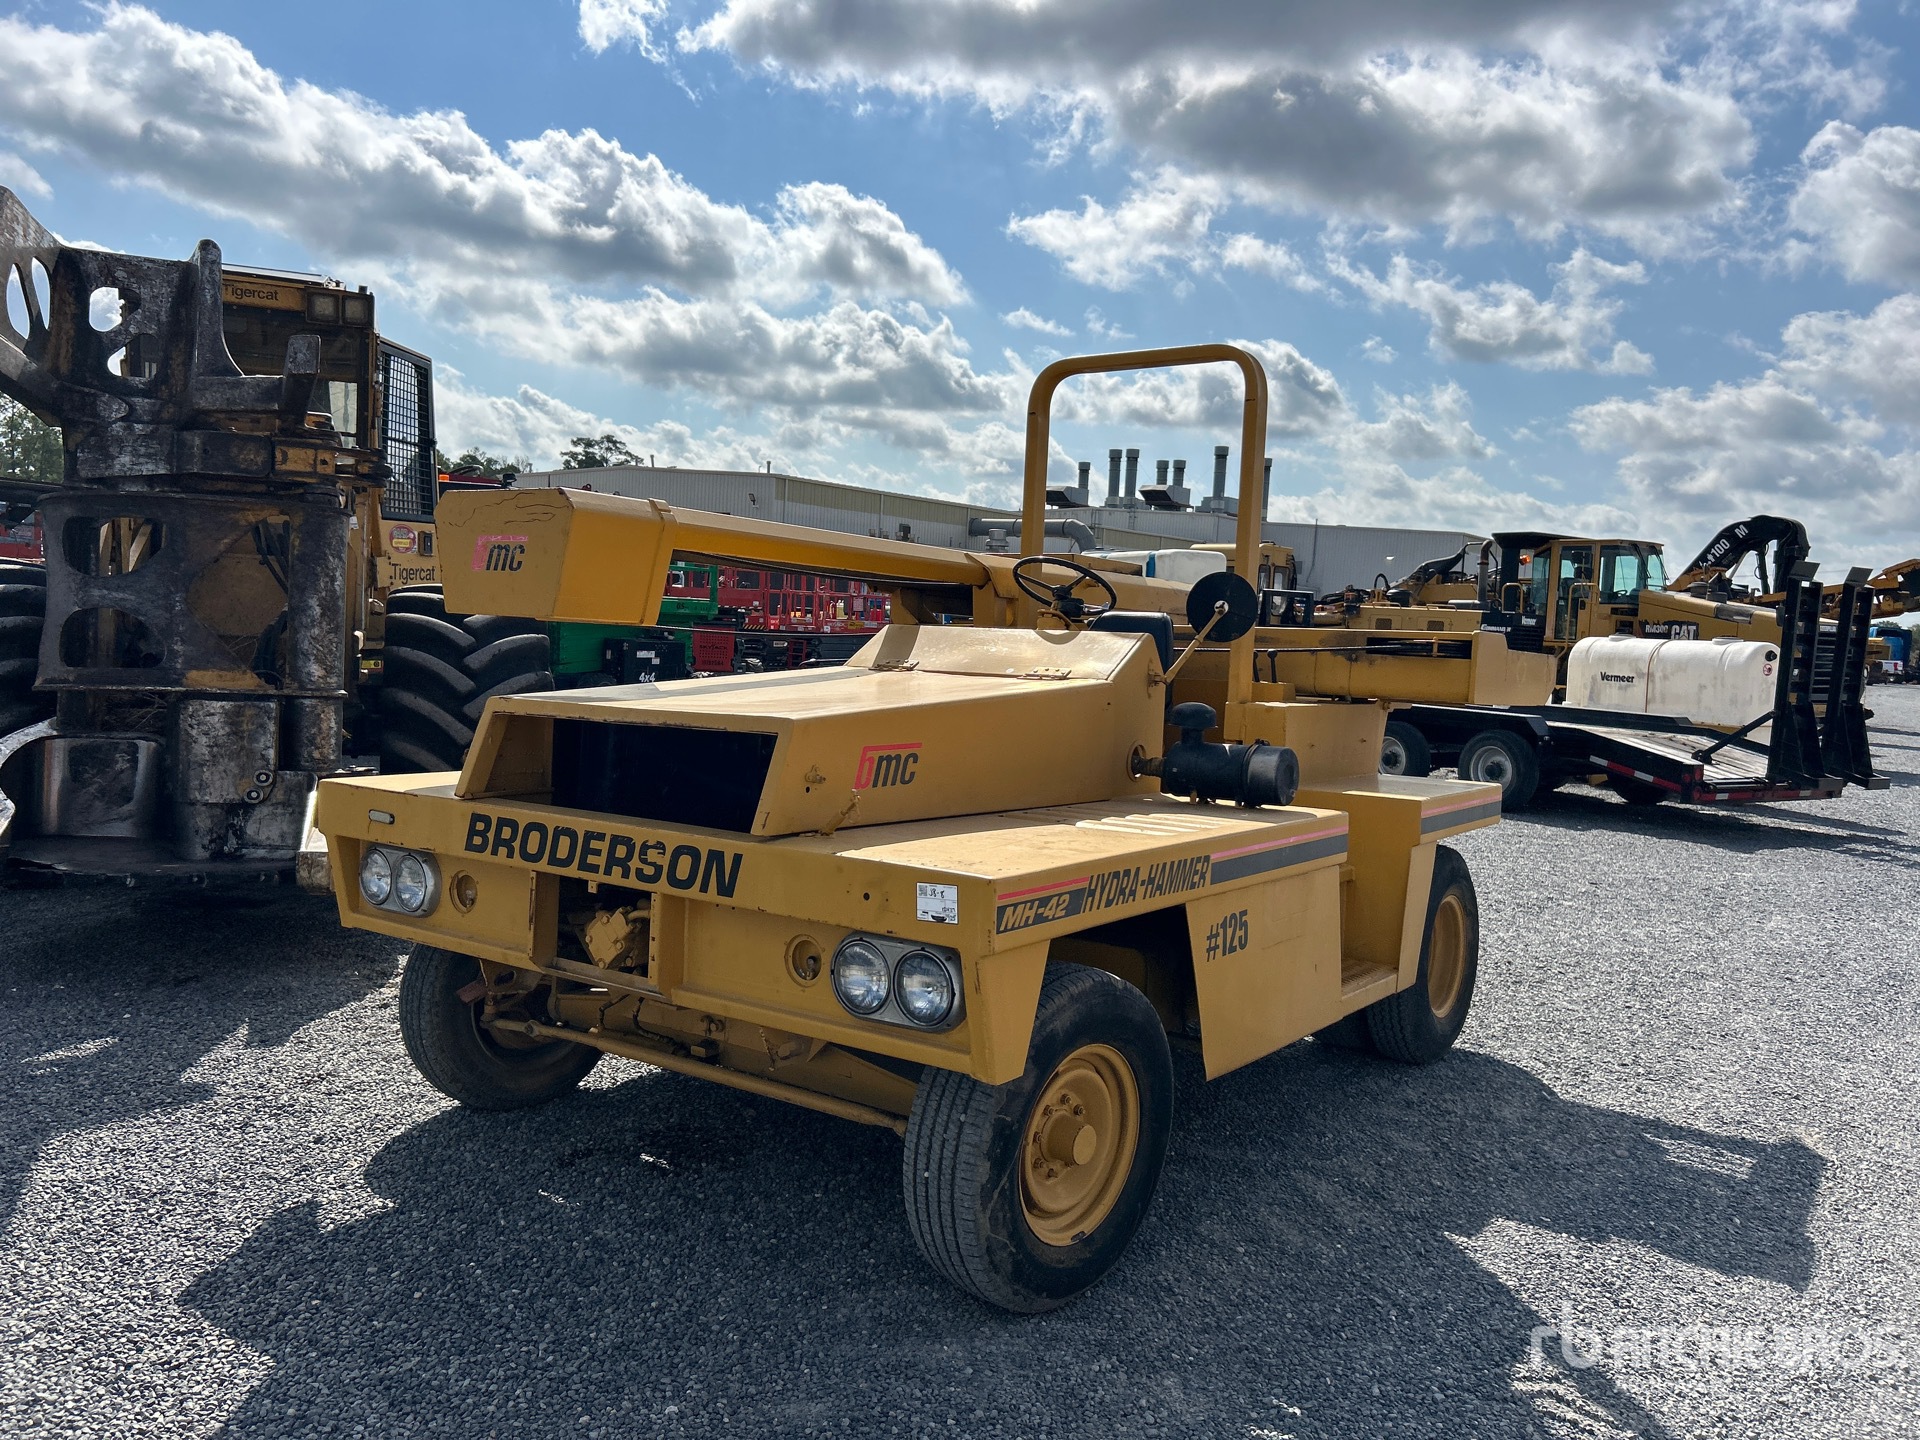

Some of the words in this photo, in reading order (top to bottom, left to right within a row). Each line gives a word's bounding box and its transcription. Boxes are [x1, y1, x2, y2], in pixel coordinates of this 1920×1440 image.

[1734, 524, 1749, 539] M
[391, 563, 435, 584] Tigercat
[1671, 624, 1697, 640] CAT
[639, 672, 655, 682] 4x4
[1600, 671, 1635, 683] Vermeer
[464, 812, 743, 898] BRODERSON
[1000, 893, 1070, 931] MH-42
[1080, 854, 1211, 914] HYDRA-HAMMER
[1206, 909, 1248, 962] #125
